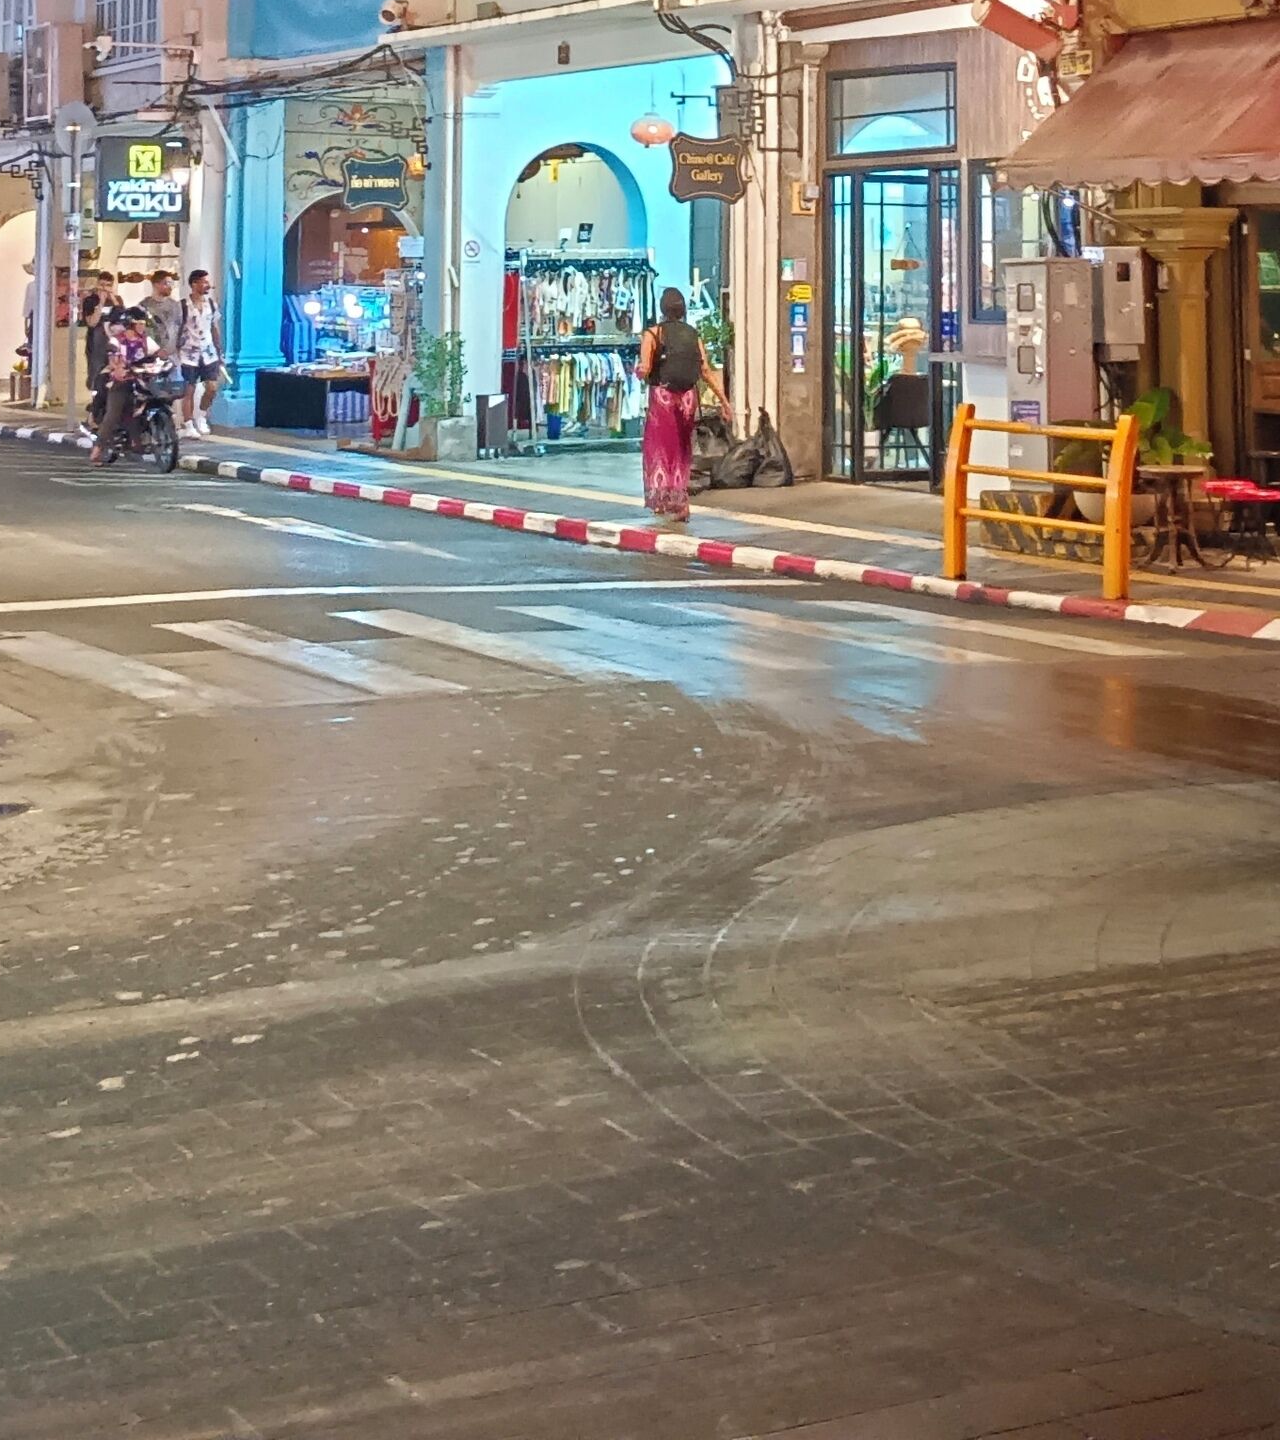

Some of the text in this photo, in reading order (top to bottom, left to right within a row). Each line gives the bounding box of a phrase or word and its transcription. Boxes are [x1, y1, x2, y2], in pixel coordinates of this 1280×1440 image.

[690, 168, 724, 184] Gallery
[108, 178, 182, 195] yakiniku
[107, 193, 183, 212] KOKU
